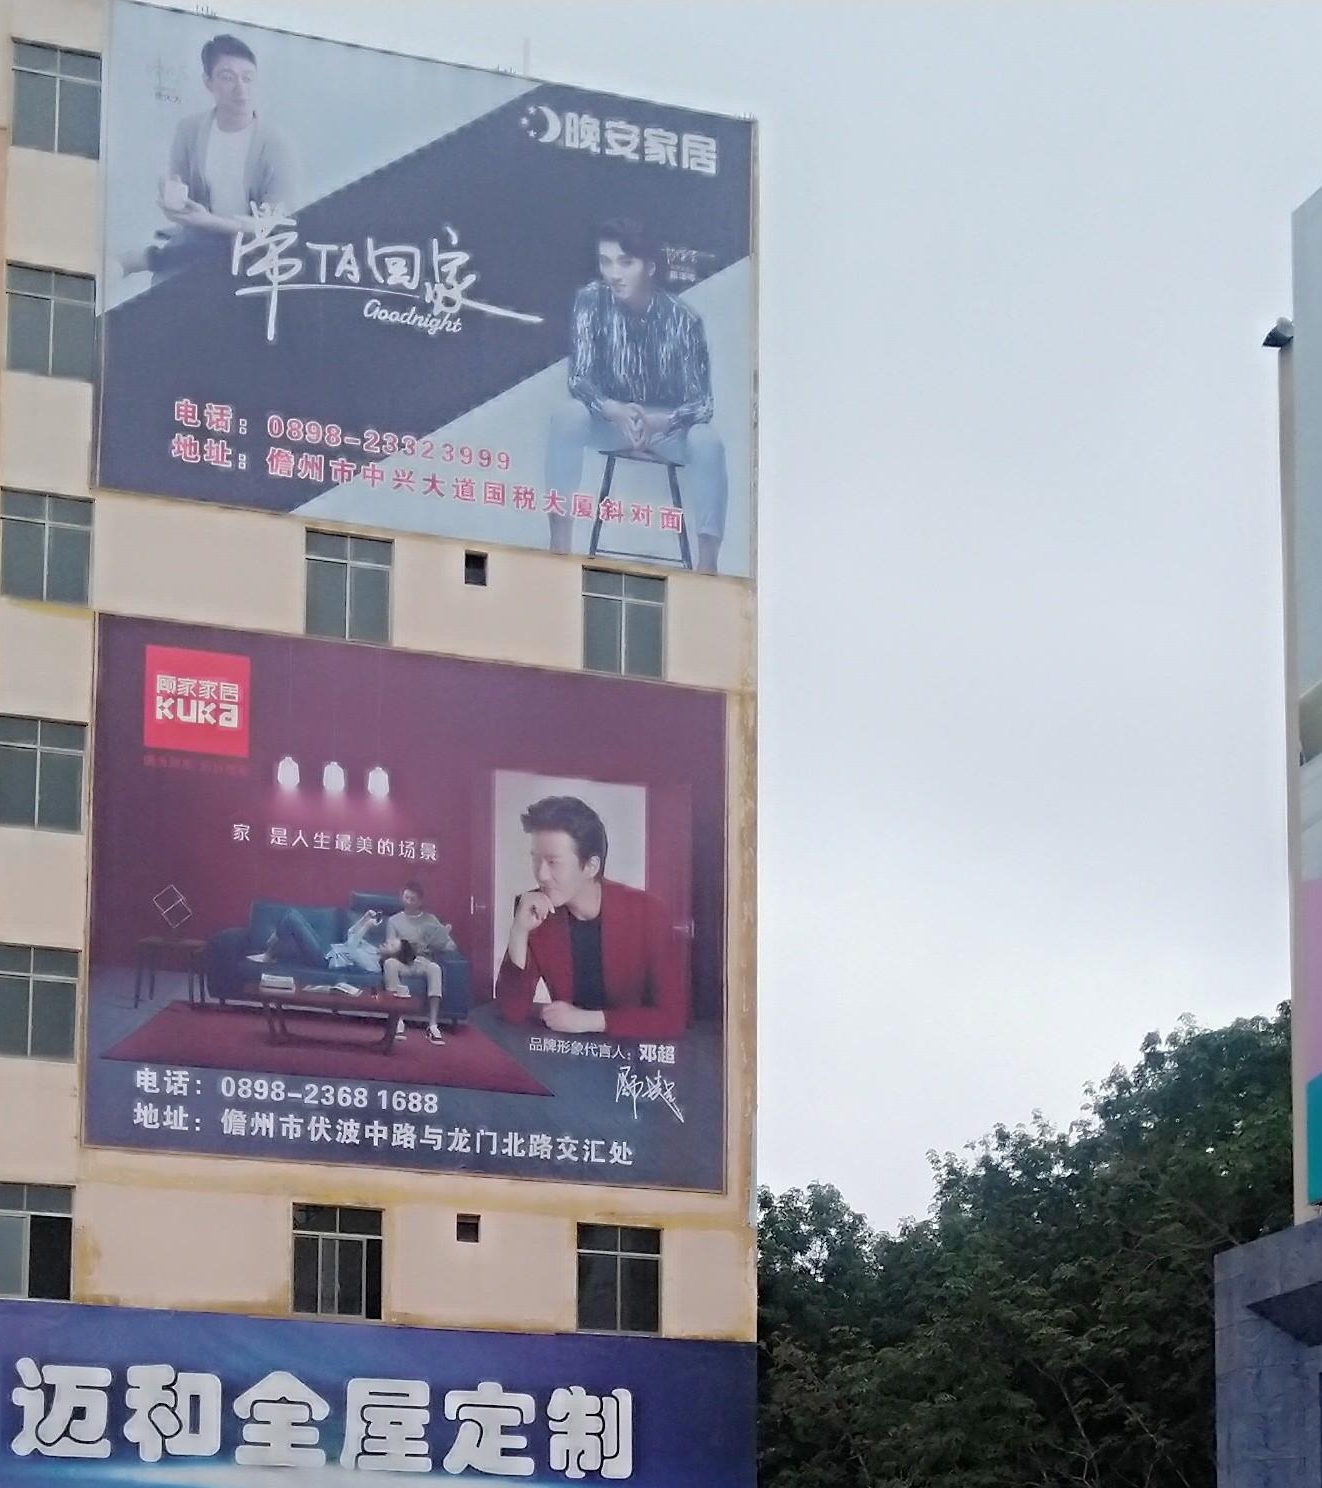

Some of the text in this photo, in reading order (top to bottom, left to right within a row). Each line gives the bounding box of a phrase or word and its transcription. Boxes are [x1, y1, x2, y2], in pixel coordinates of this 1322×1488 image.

[563, 110, 718, 175] 晚安家居
[362, 296, 464, 337] Goodnight
[156, 674, 239, 702] 顾家家居
[232, 823, 439, 863] 家 是人生最美的场景
[11, 1356, 634, 1480] 迈和全屋定制
